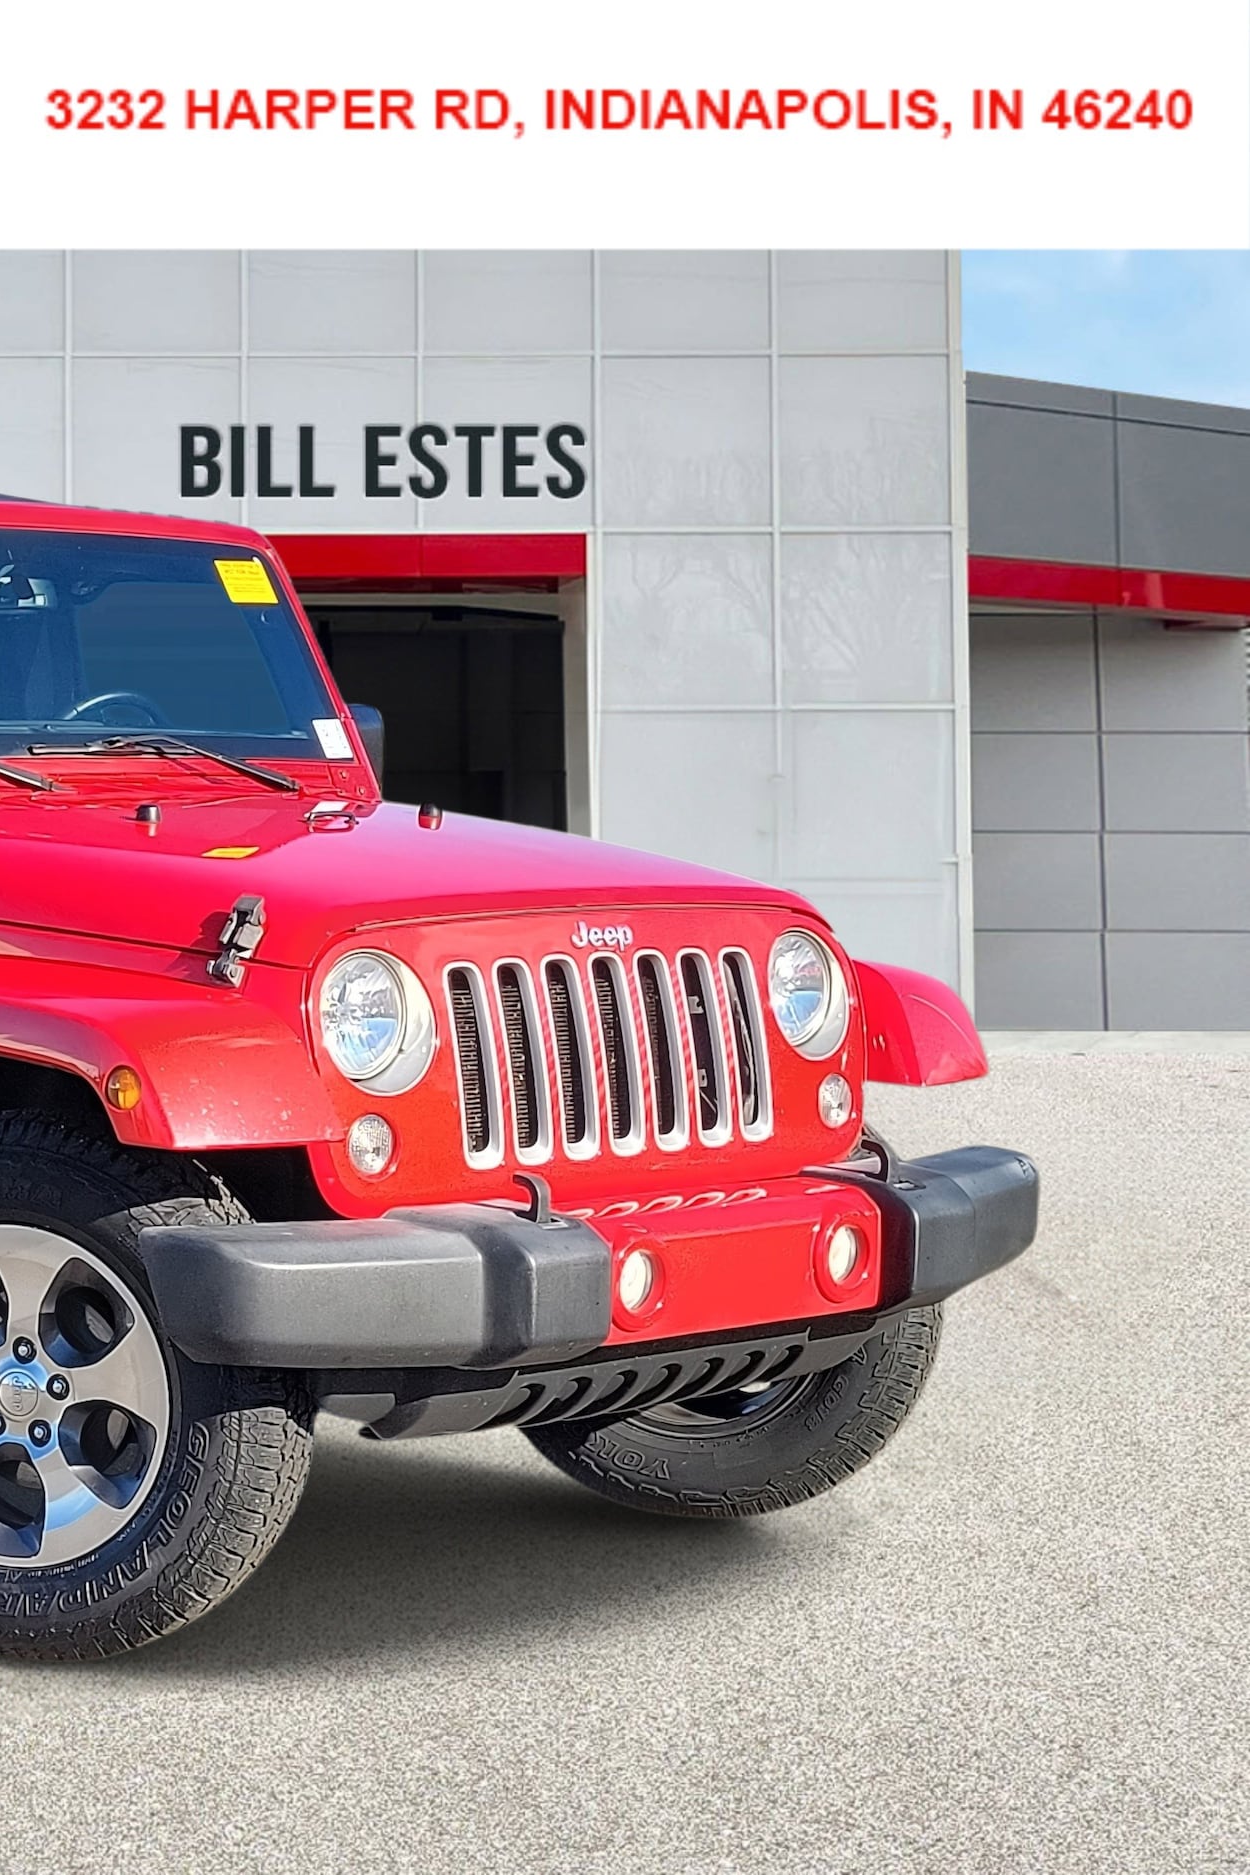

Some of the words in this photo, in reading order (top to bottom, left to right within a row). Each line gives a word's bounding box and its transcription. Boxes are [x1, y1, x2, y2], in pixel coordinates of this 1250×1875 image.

[180, 425, 335, 498] BILL
[365, 424, 586, 499] ESTES
[571, 920, 633, 952] Jeep
